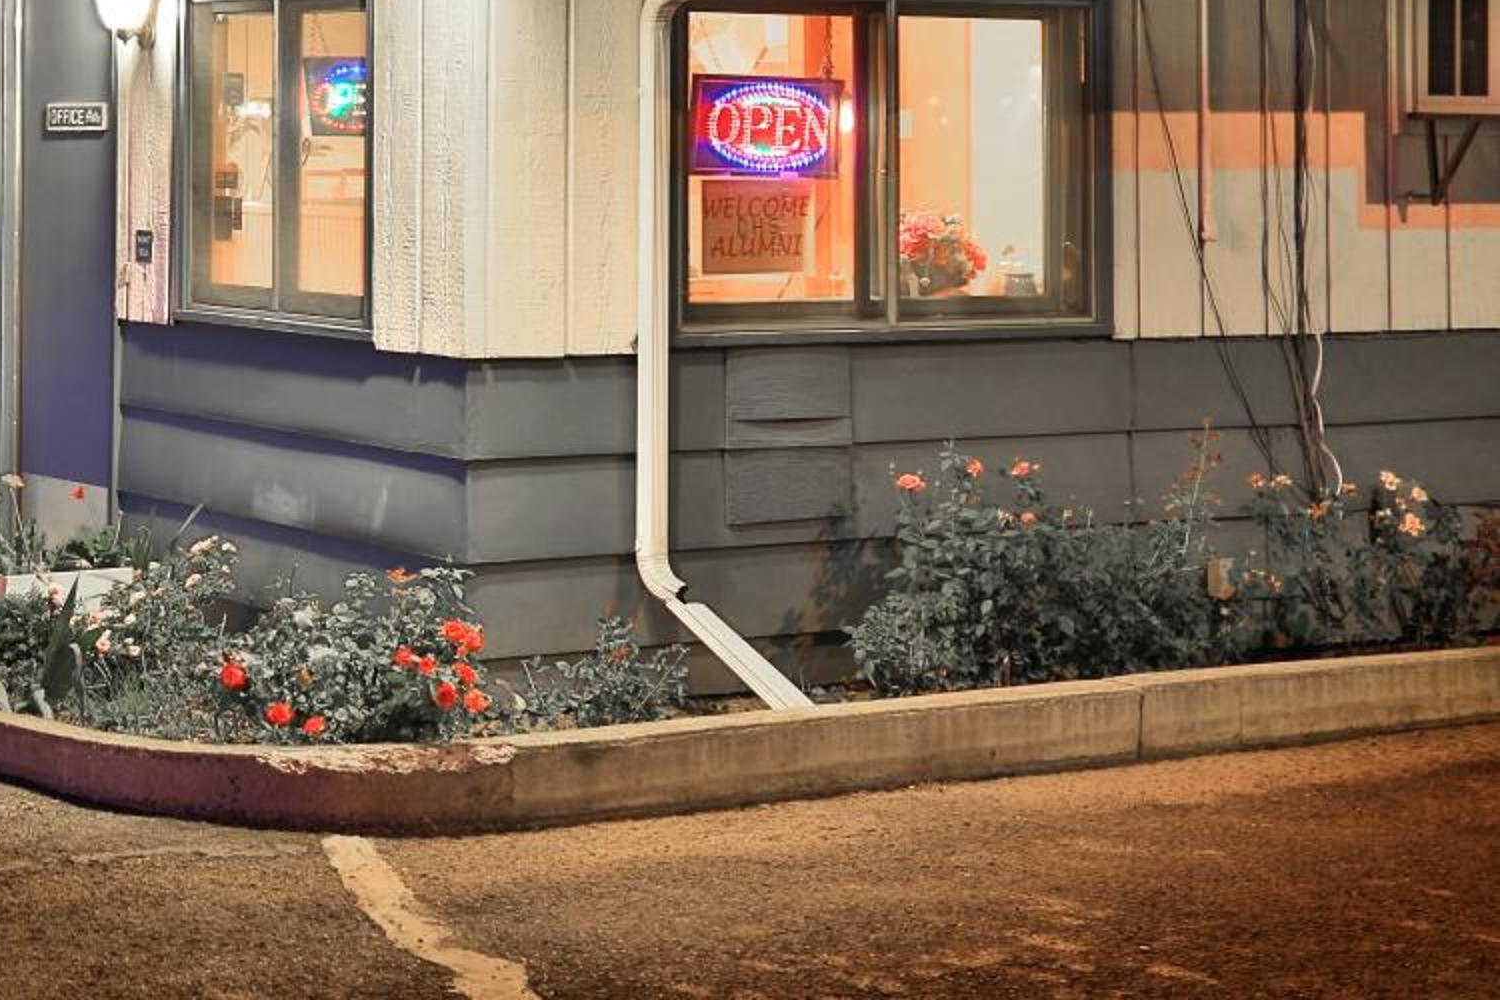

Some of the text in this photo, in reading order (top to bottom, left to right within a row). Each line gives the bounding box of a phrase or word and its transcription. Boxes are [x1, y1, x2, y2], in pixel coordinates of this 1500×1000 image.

[51, 109, 85, 125] OFFICE
[708, 100, 830, 151] OPEN
[703, 194, 811, 218] WELCOME
[710, 234, 804, 257] ALUMNI
